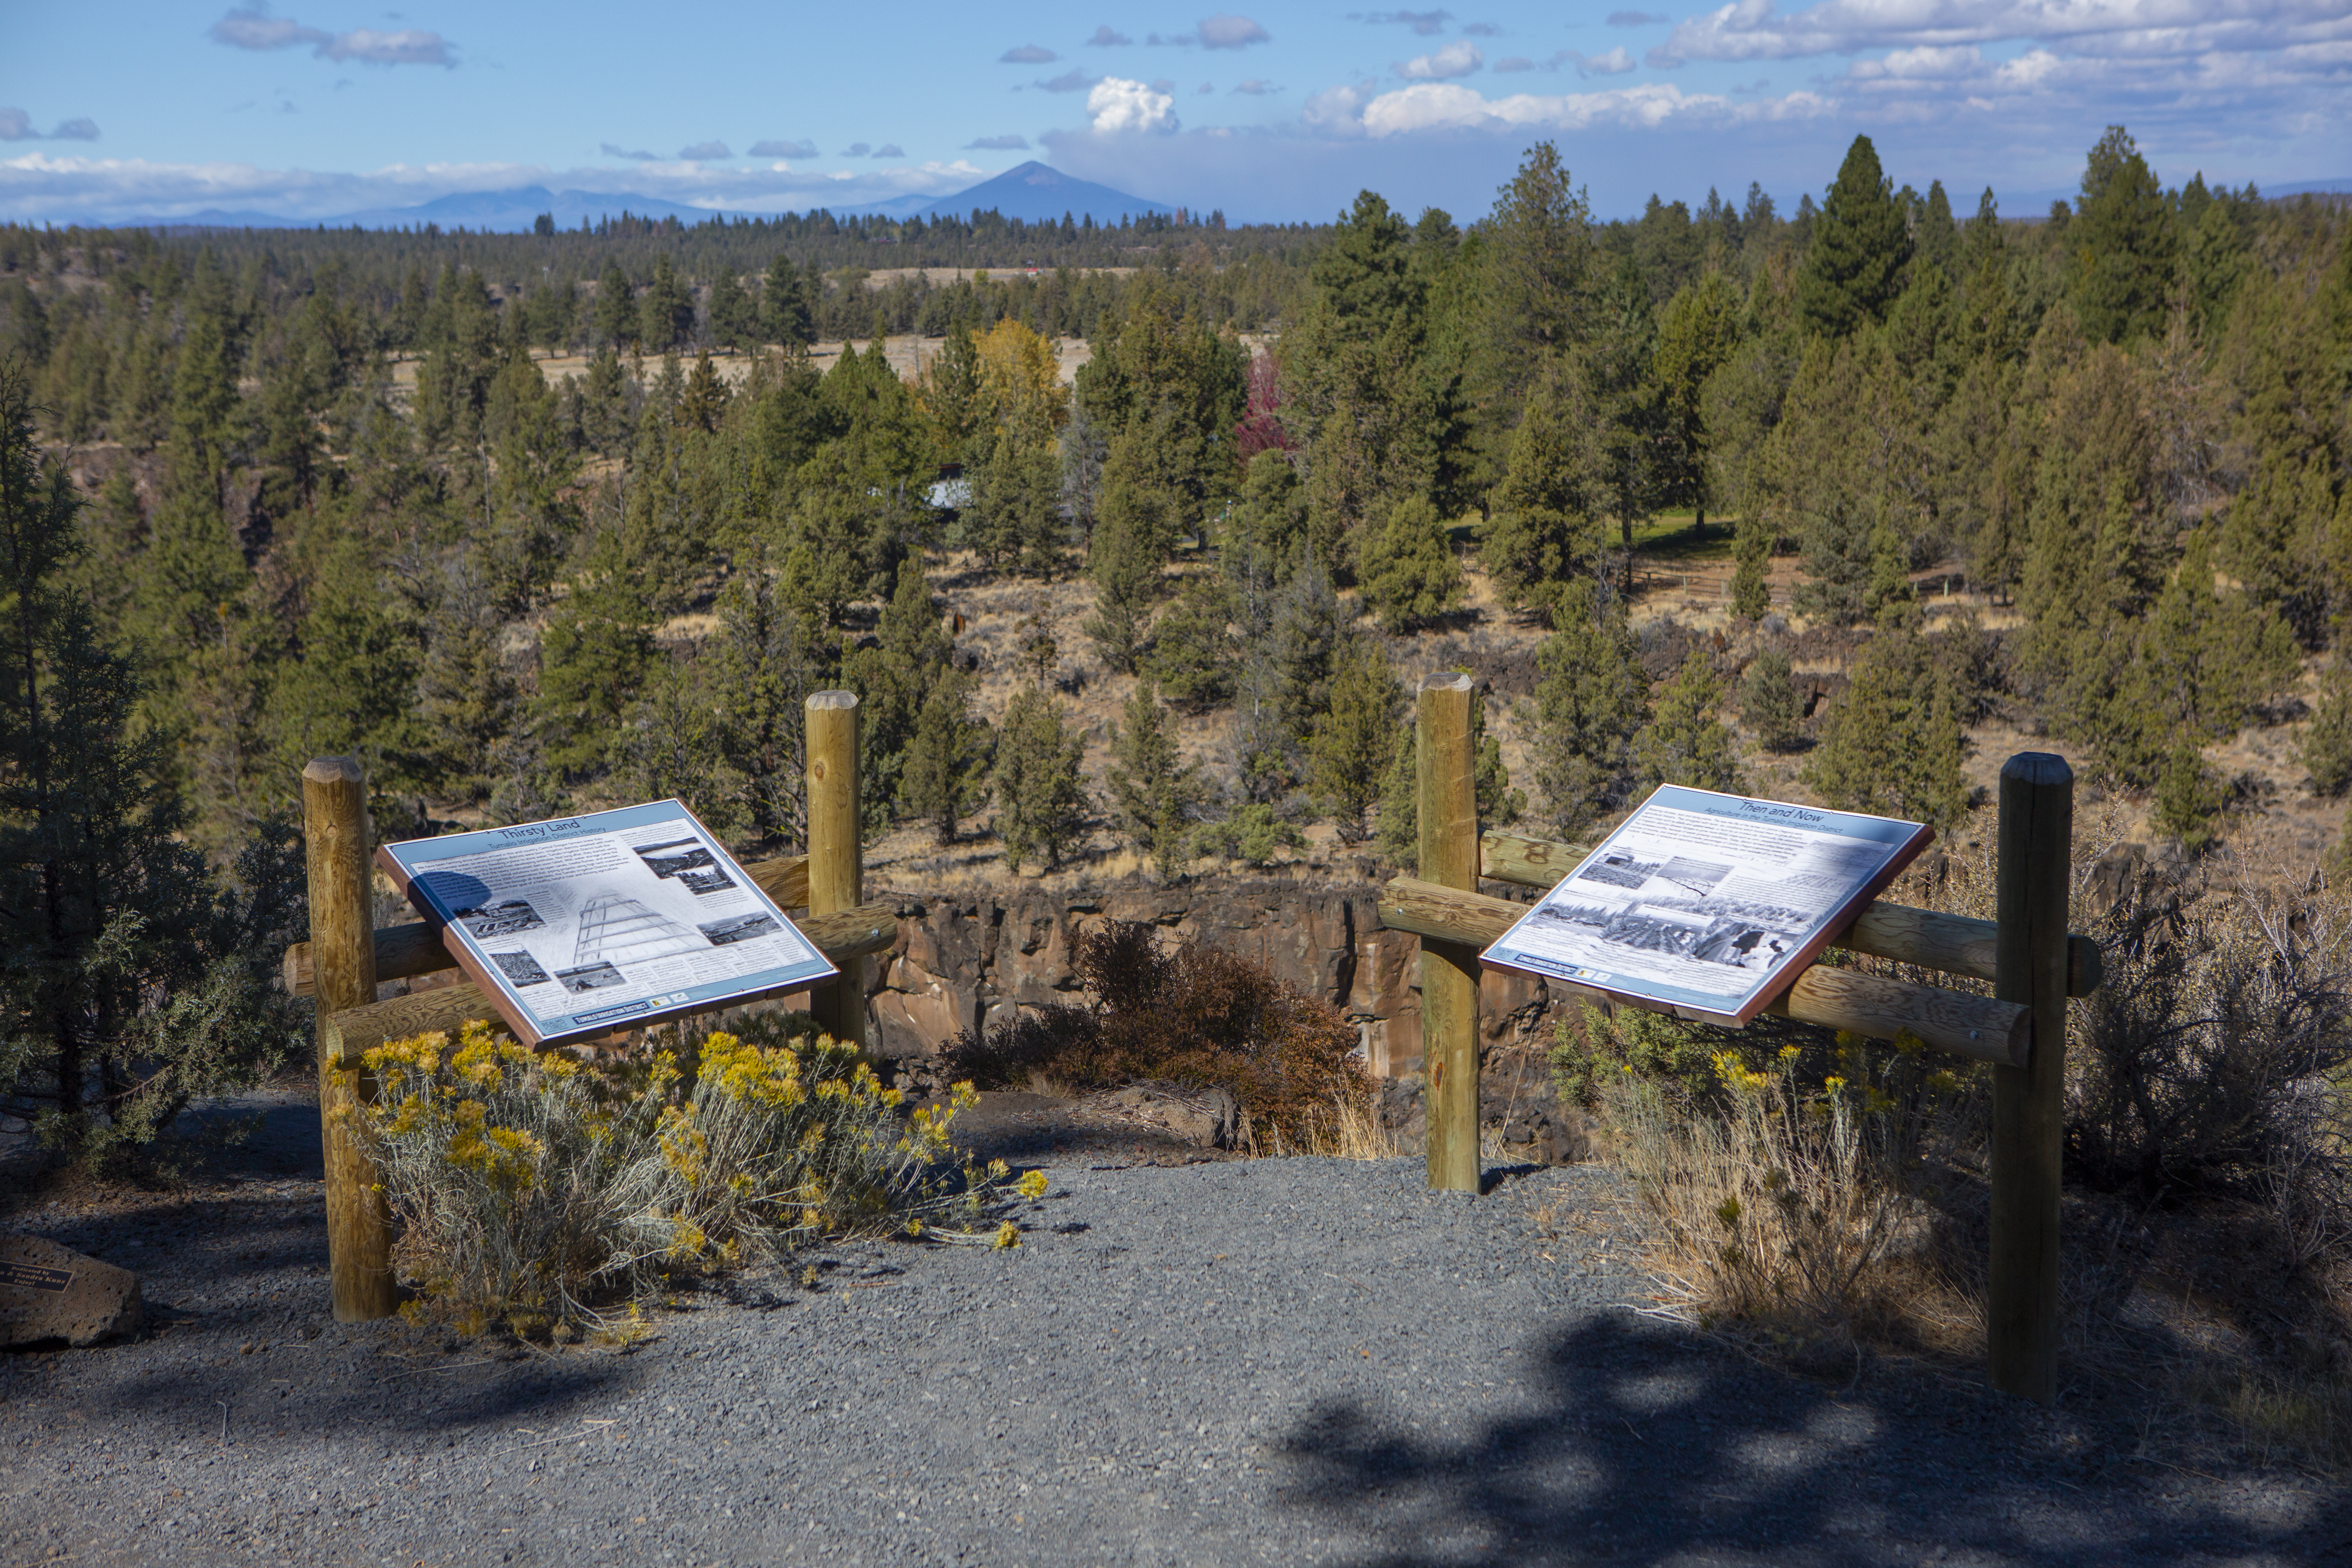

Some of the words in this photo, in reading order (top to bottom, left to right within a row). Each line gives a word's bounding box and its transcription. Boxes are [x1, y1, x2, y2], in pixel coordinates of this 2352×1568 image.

[1704, 807, 1741, 817] Agriculture
[1762, 815, 1786, 824] Tumalo
[1786, 820, 1817, 830] Irrigation
[1817, 824, 1843, 833] District
[1739, 802, 1767, 813] Then
[1769, 808, 1796, 817] and
[1793, 810, 1825, 822] Now
[498, 826, 545, 839] Thirsty
[546, 820, 581, 832] Land
[487, 840, 517, 849] Tumalo
[518, 835, 552, 844] Irrigation
[552, 831, 579, 839] District
[575, 1014, 598, 1023] TUMALO
[597, 1008, 625, 1019] IRRIGATION
[624, 1003, 648, 1013] DISTRICT
[16, 1272, 43, 1281] Sandra
